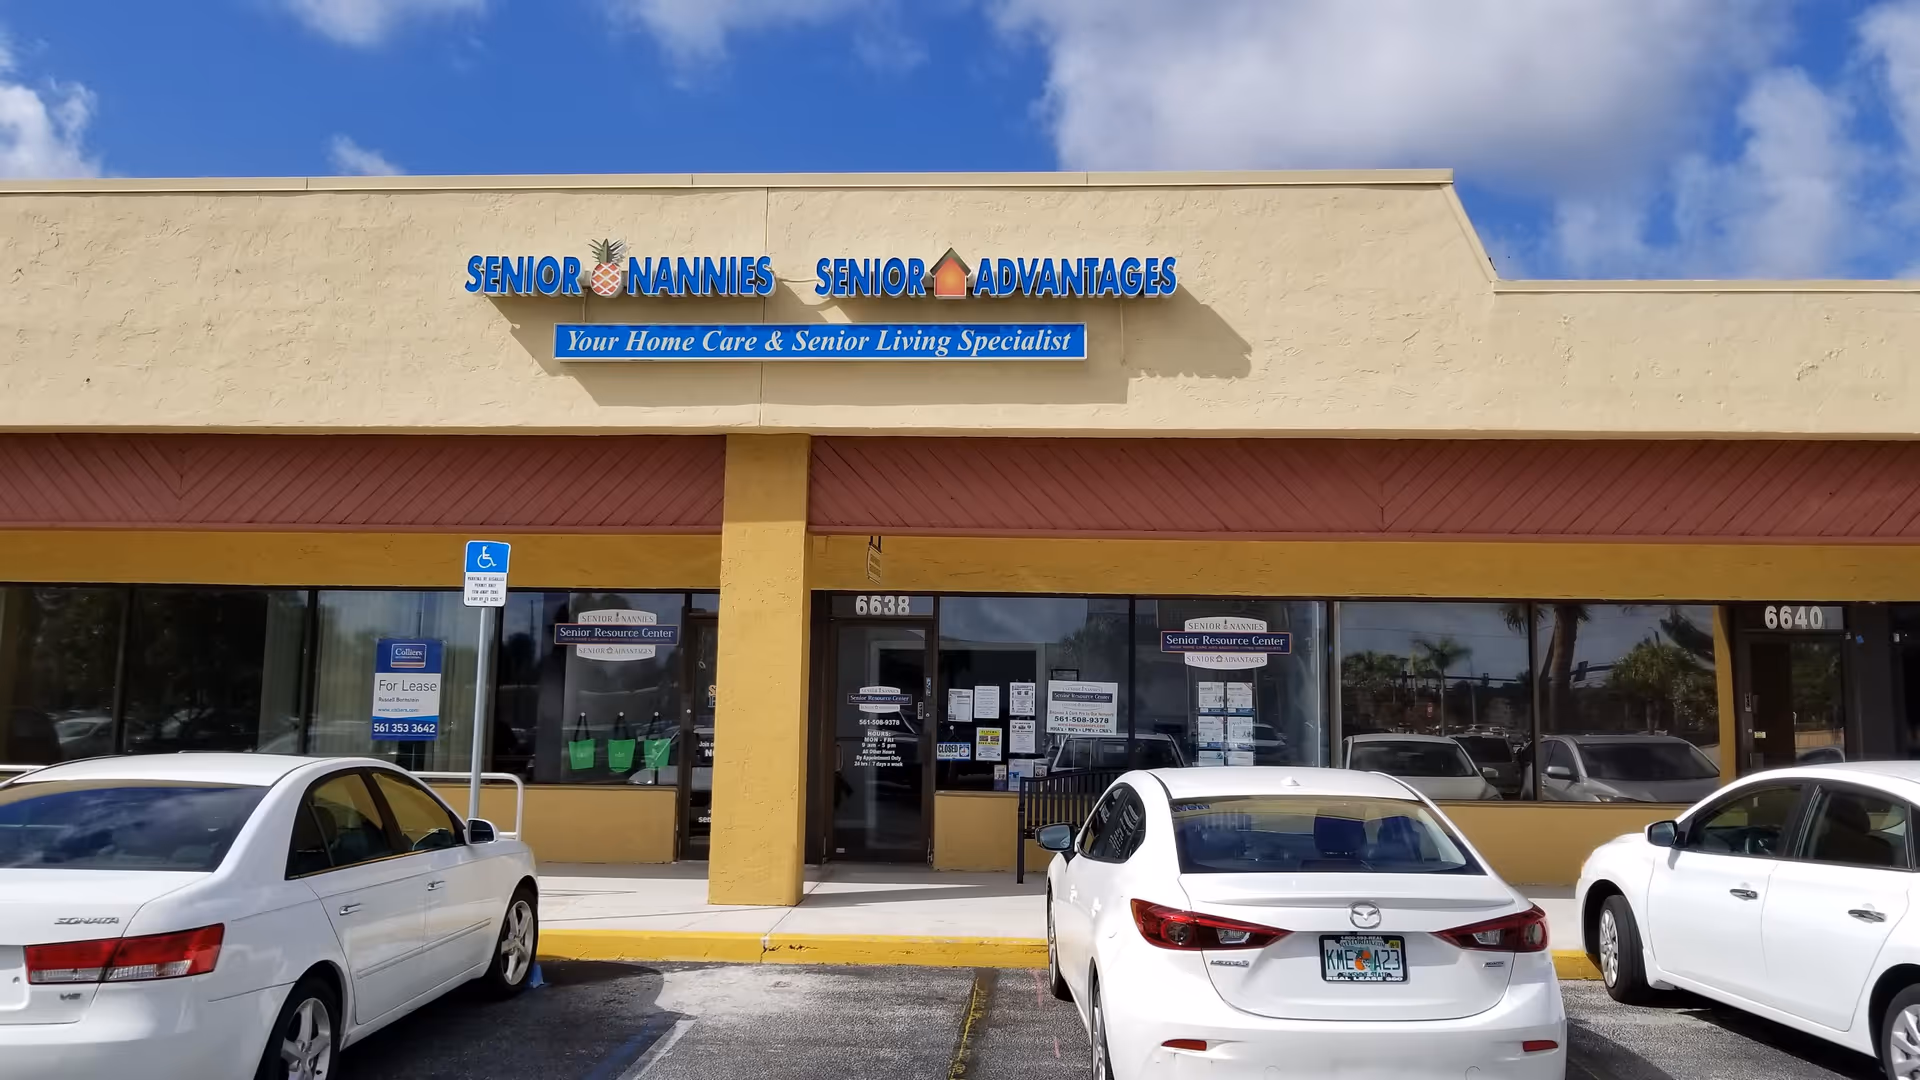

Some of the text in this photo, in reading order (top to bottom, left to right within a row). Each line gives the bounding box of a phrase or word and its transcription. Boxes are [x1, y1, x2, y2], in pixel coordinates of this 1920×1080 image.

[464, 255, 775, 296] SENIOR NANNIES
[814, 256, 1178, 297] SENIOR ADVANTAGES
[567, 329, 1071, 357] Your Home Care & Senior Living Specialist
[856, 595, 910, 616] 6638
[582, 615, 613, 623] SENIOR
[1764, 605, 1823, 630] 6640
[1188, 622, 1264, 631] SENIOR NANNIES
[560, 627, 674, 638] Senior Resource Center
[1166, 635, 1285, 646] Senior Resource Center
[395, 648, 423, 656] Colliers
[578, 647, 605, 655] SENIOR
[1224, 656, 1265, 664] ADVANTAGES
[378, 680, 437, 692] For Lease
[1054, 716, 1109, 724] 561-508-9378
[373, 723, 436, 733] 561 353 3642
[937, 744, 958, 753] CLOSED
[1326, 949, 1400, 970] KME A23
